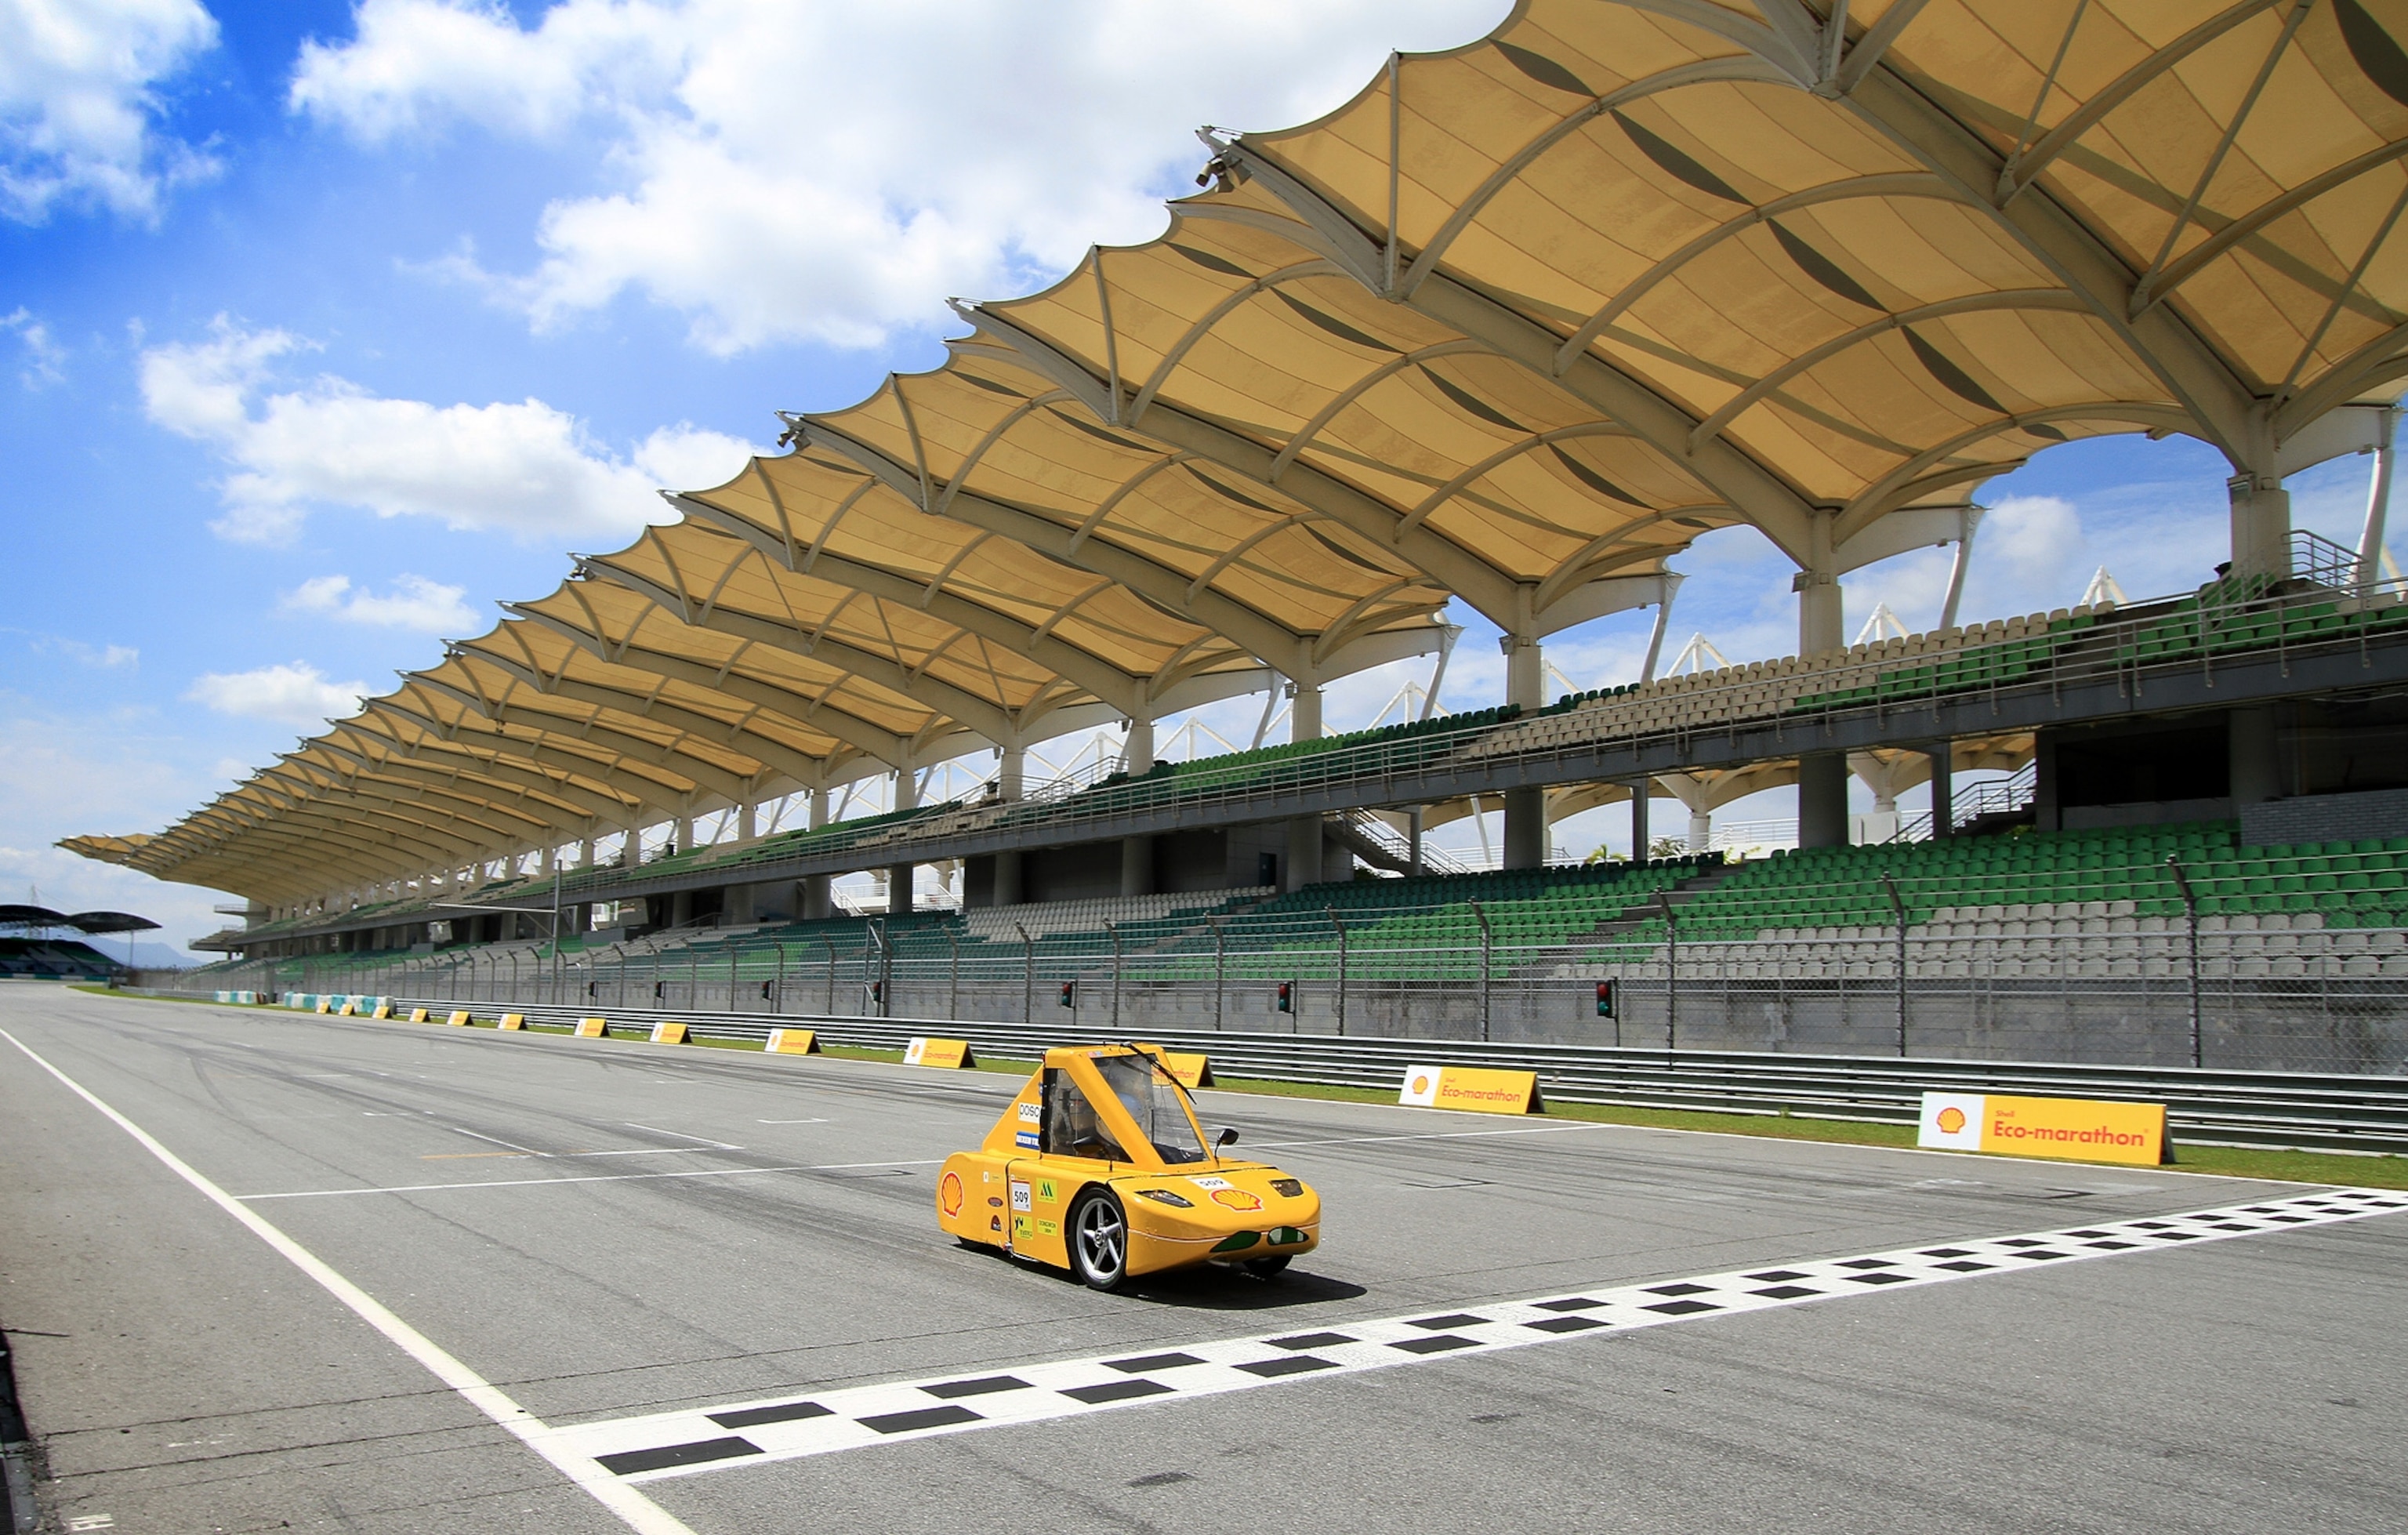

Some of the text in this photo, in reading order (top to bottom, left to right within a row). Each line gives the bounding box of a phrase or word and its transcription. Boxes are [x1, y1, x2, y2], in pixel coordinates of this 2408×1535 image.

[1442, 1085, 1521, 1103] Eco-marathon
[1993, 1120, 2145, 1147] Eco-marathon
[1014, 1191, 1029, 1204] 509
